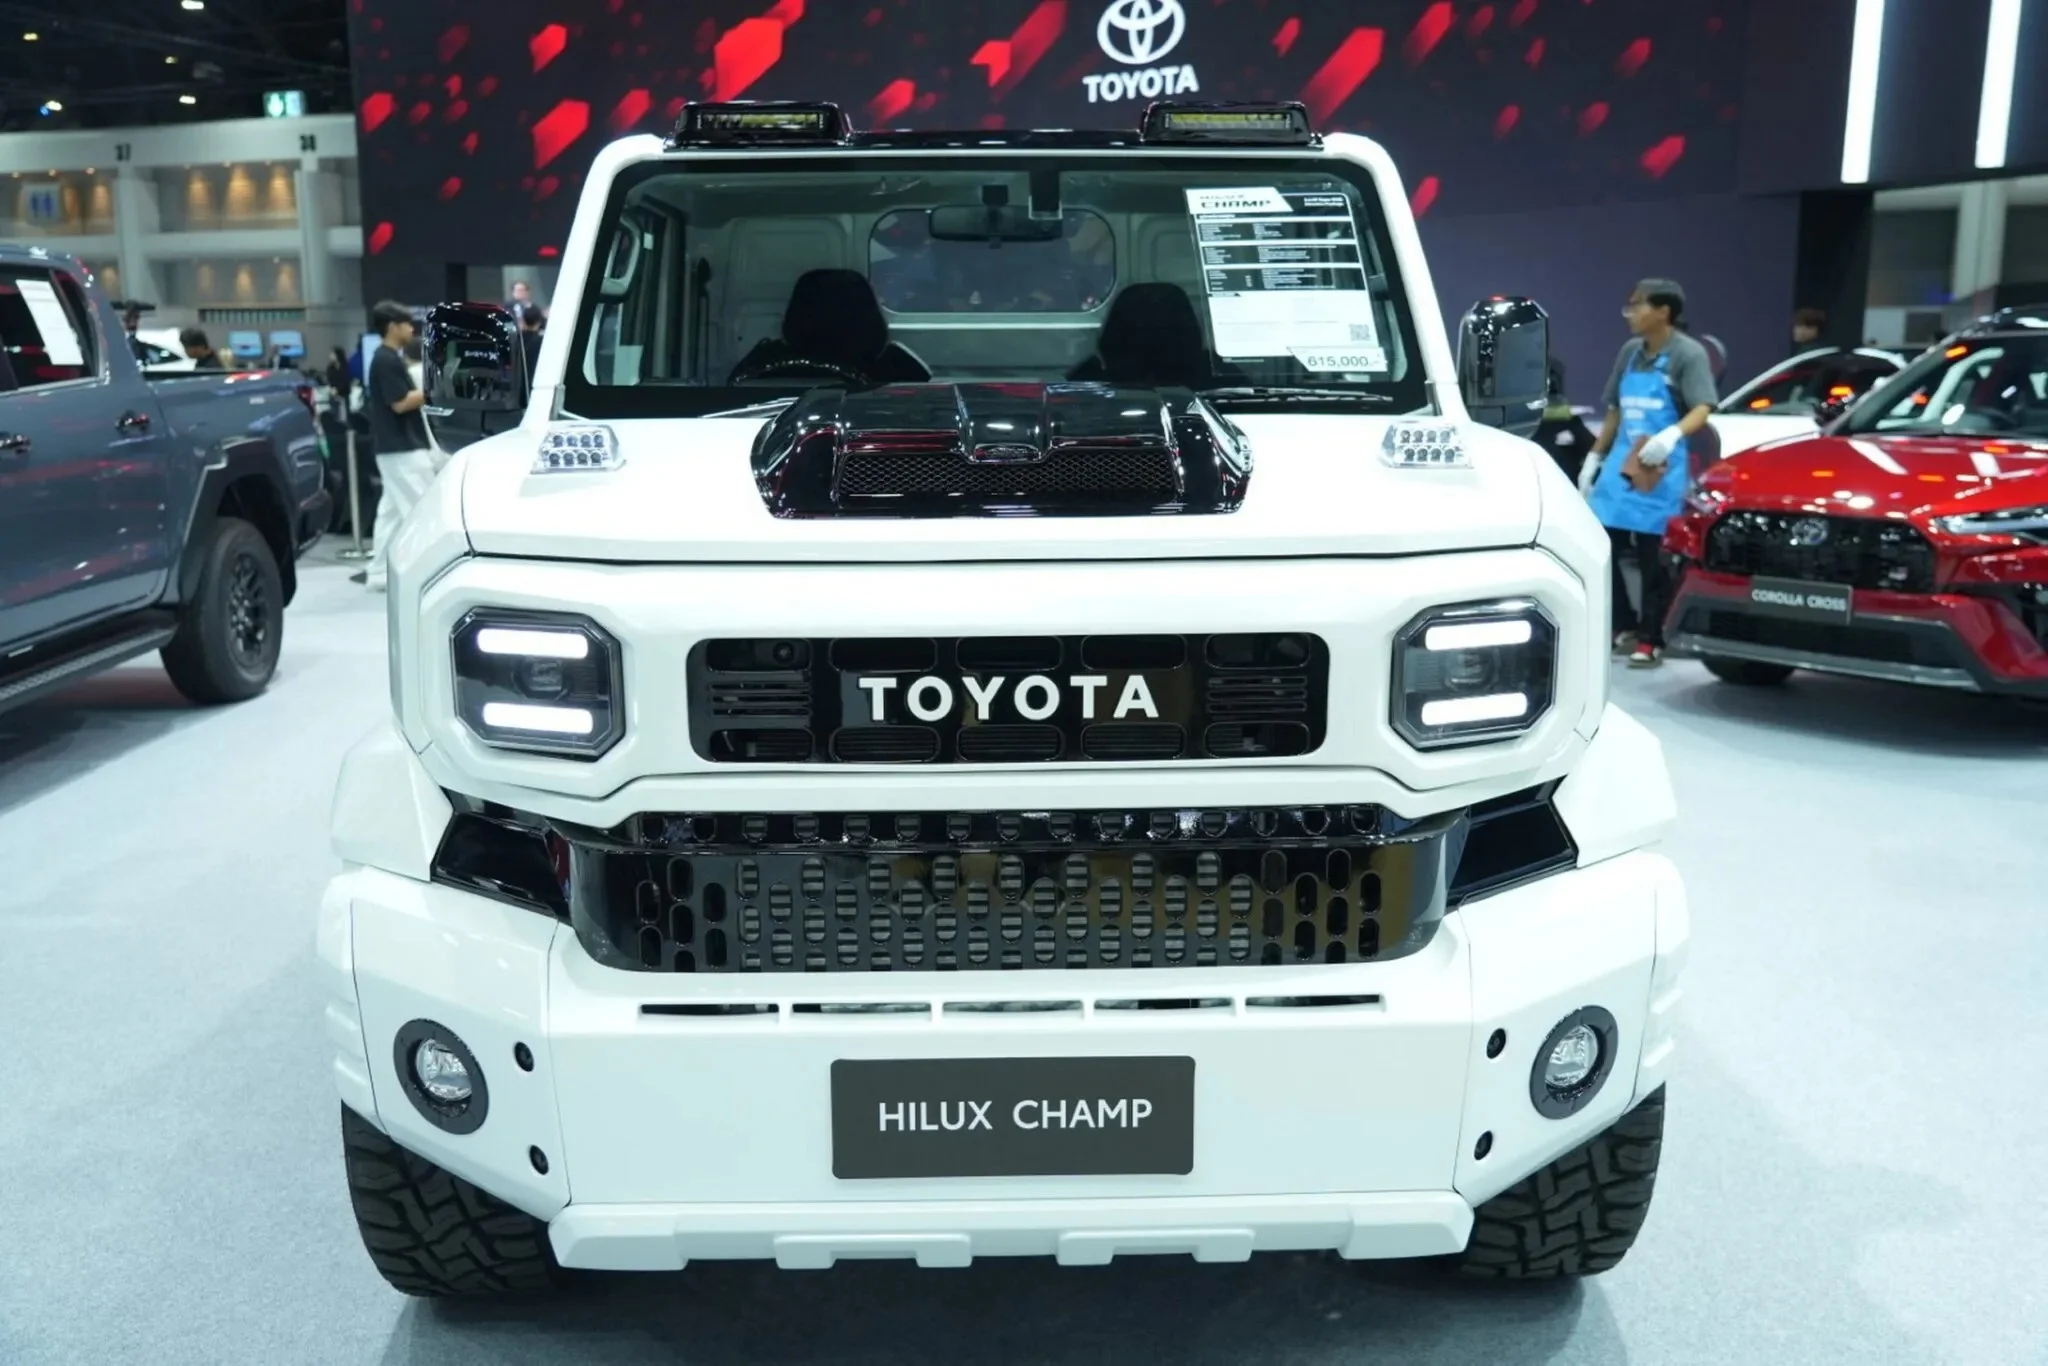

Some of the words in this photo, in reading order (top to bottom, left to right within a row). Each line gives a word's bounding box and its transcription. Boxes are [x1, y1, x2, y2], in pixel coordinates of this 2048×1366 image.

[1082, 64, 1199, 103] TOYOTA
[1752, 588, 1805, 606] COROLLA
[1807, 594, 1847, 611] CROSS
[858, 674, 1159, 722] TOYOTA
[879, 1101, 993, 1132] HILUX
[1012, 1098, 1153, 1130] CHAMP
